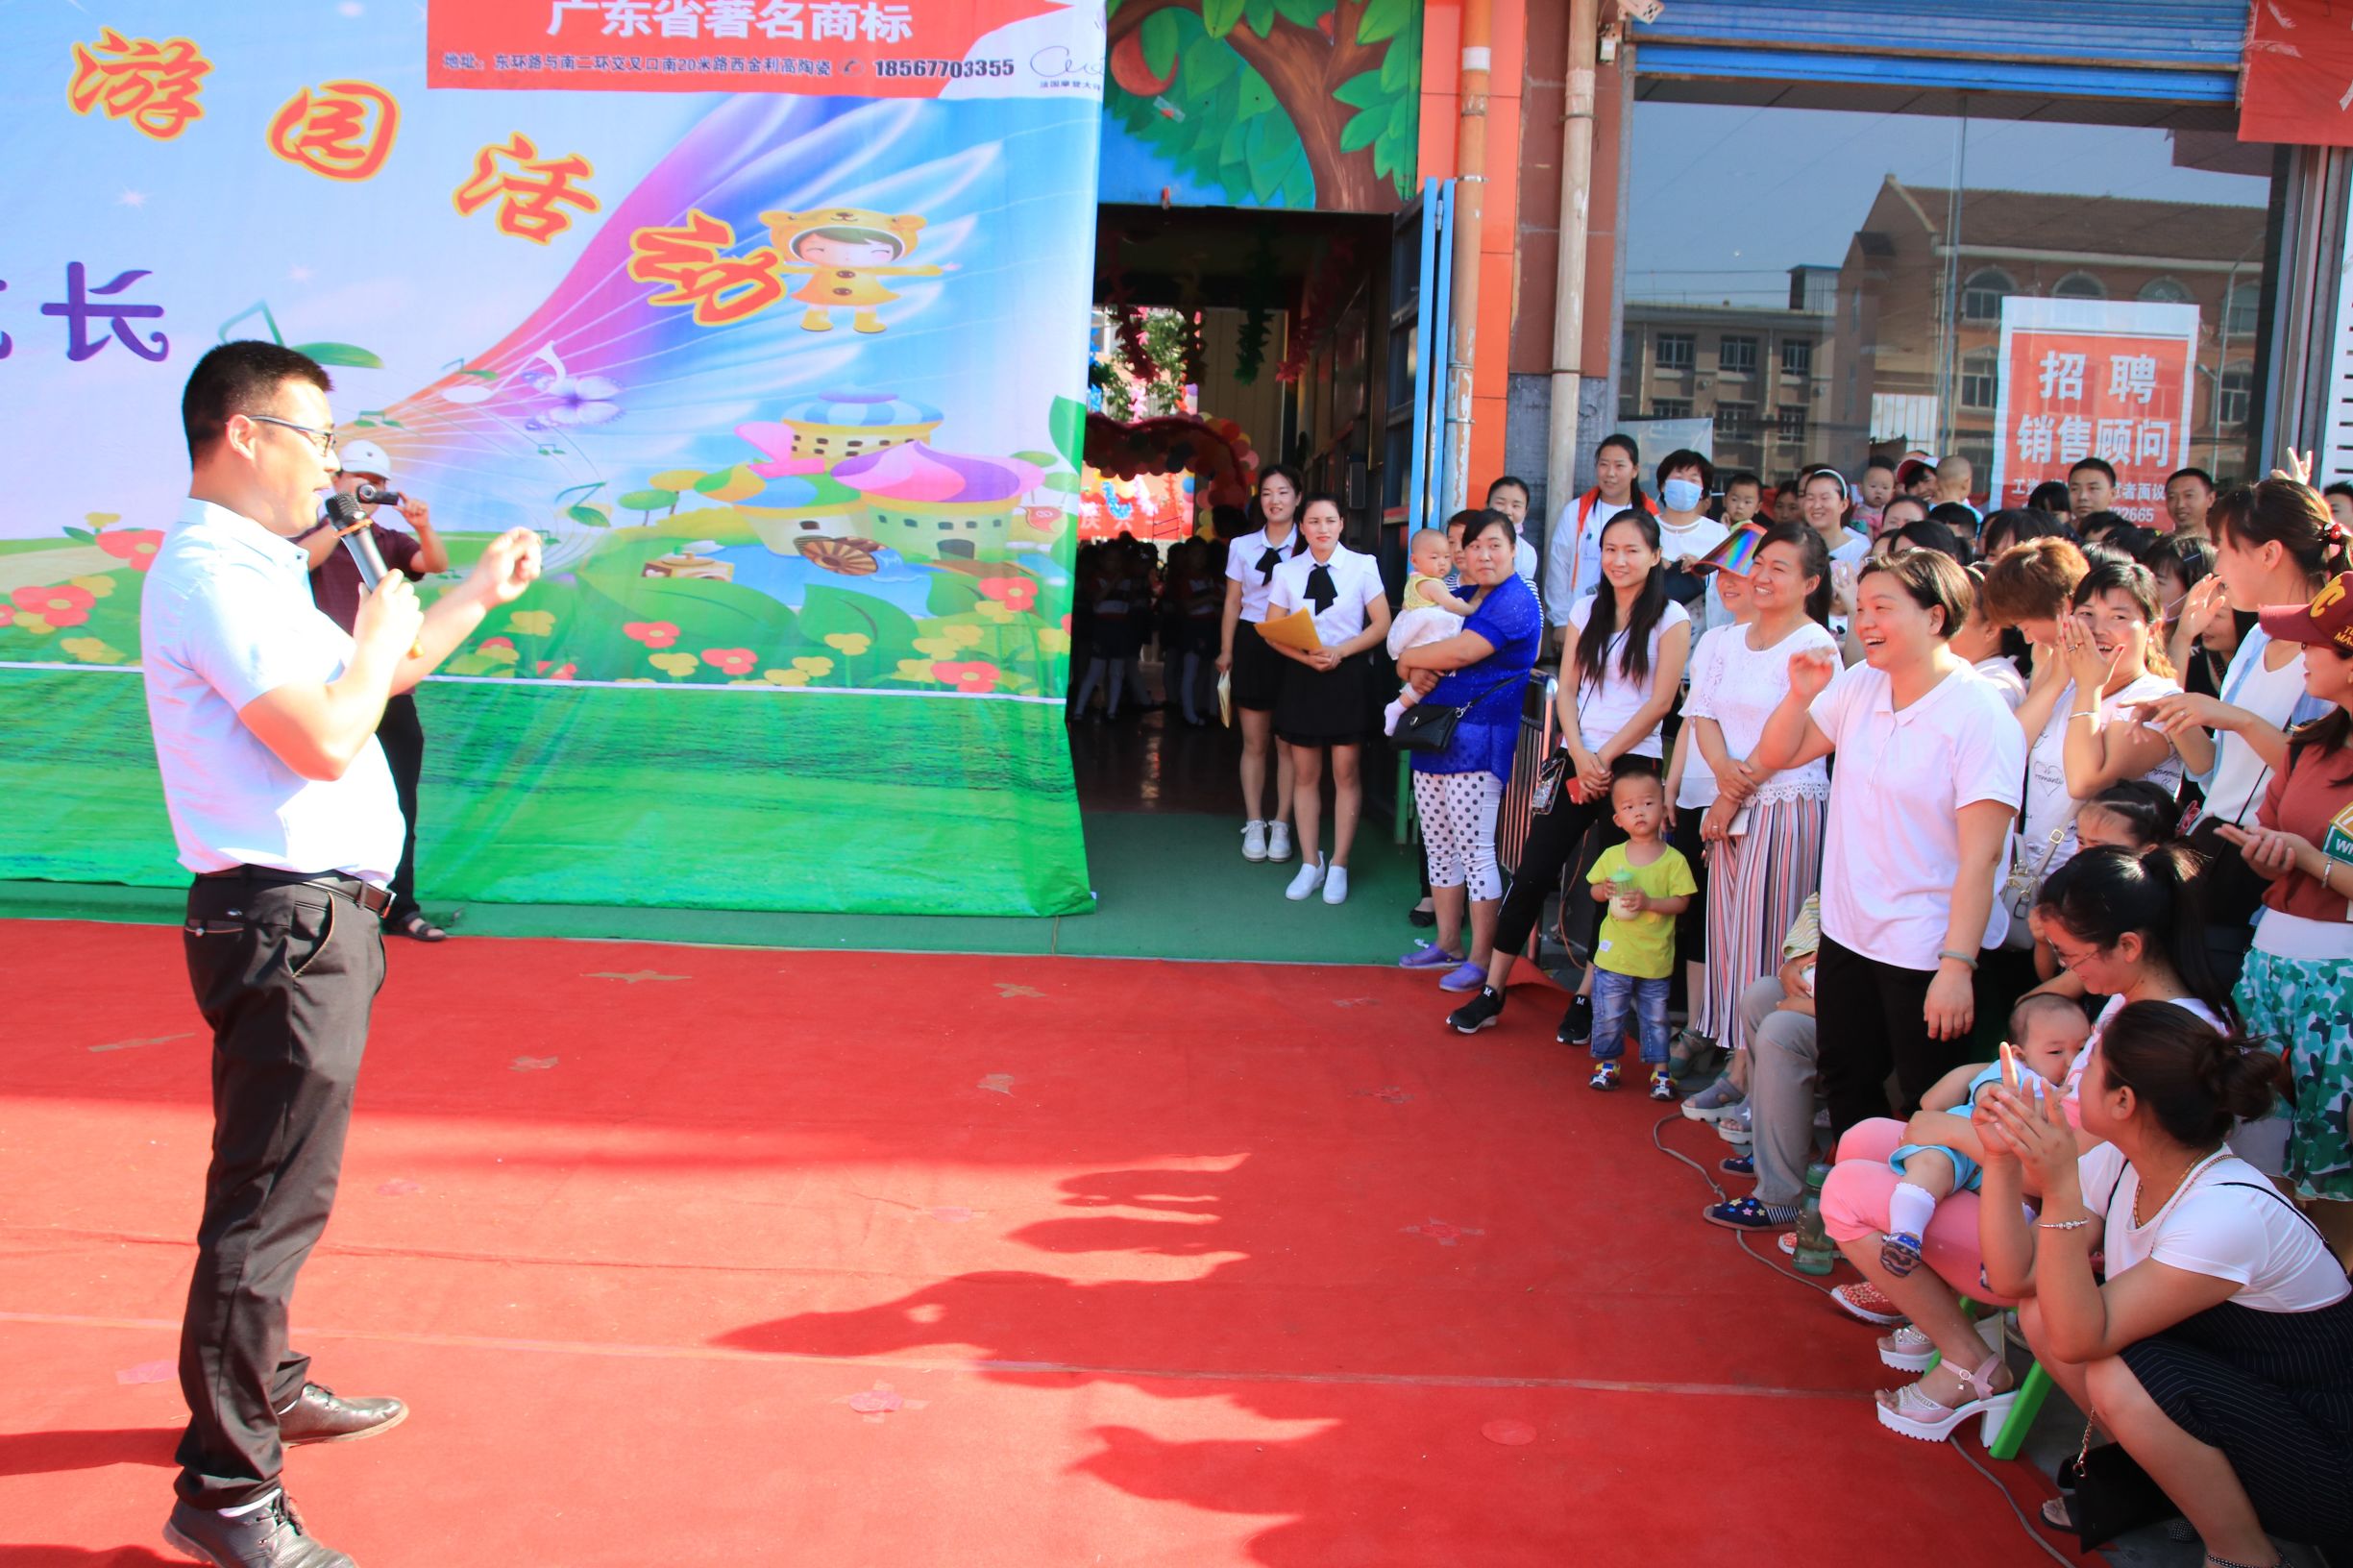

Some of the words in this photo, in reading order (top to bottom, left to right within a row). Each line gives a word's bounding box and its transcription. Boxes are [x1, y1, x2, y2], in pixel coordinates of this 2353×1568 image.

[545, 0, 914, 43] 广东省著名商标
[874, 59, 1015, 79] 18567703355
[2038, 350, 2157, 404] 招聘
[2017, 414, 2171, 469] 销售顾问
